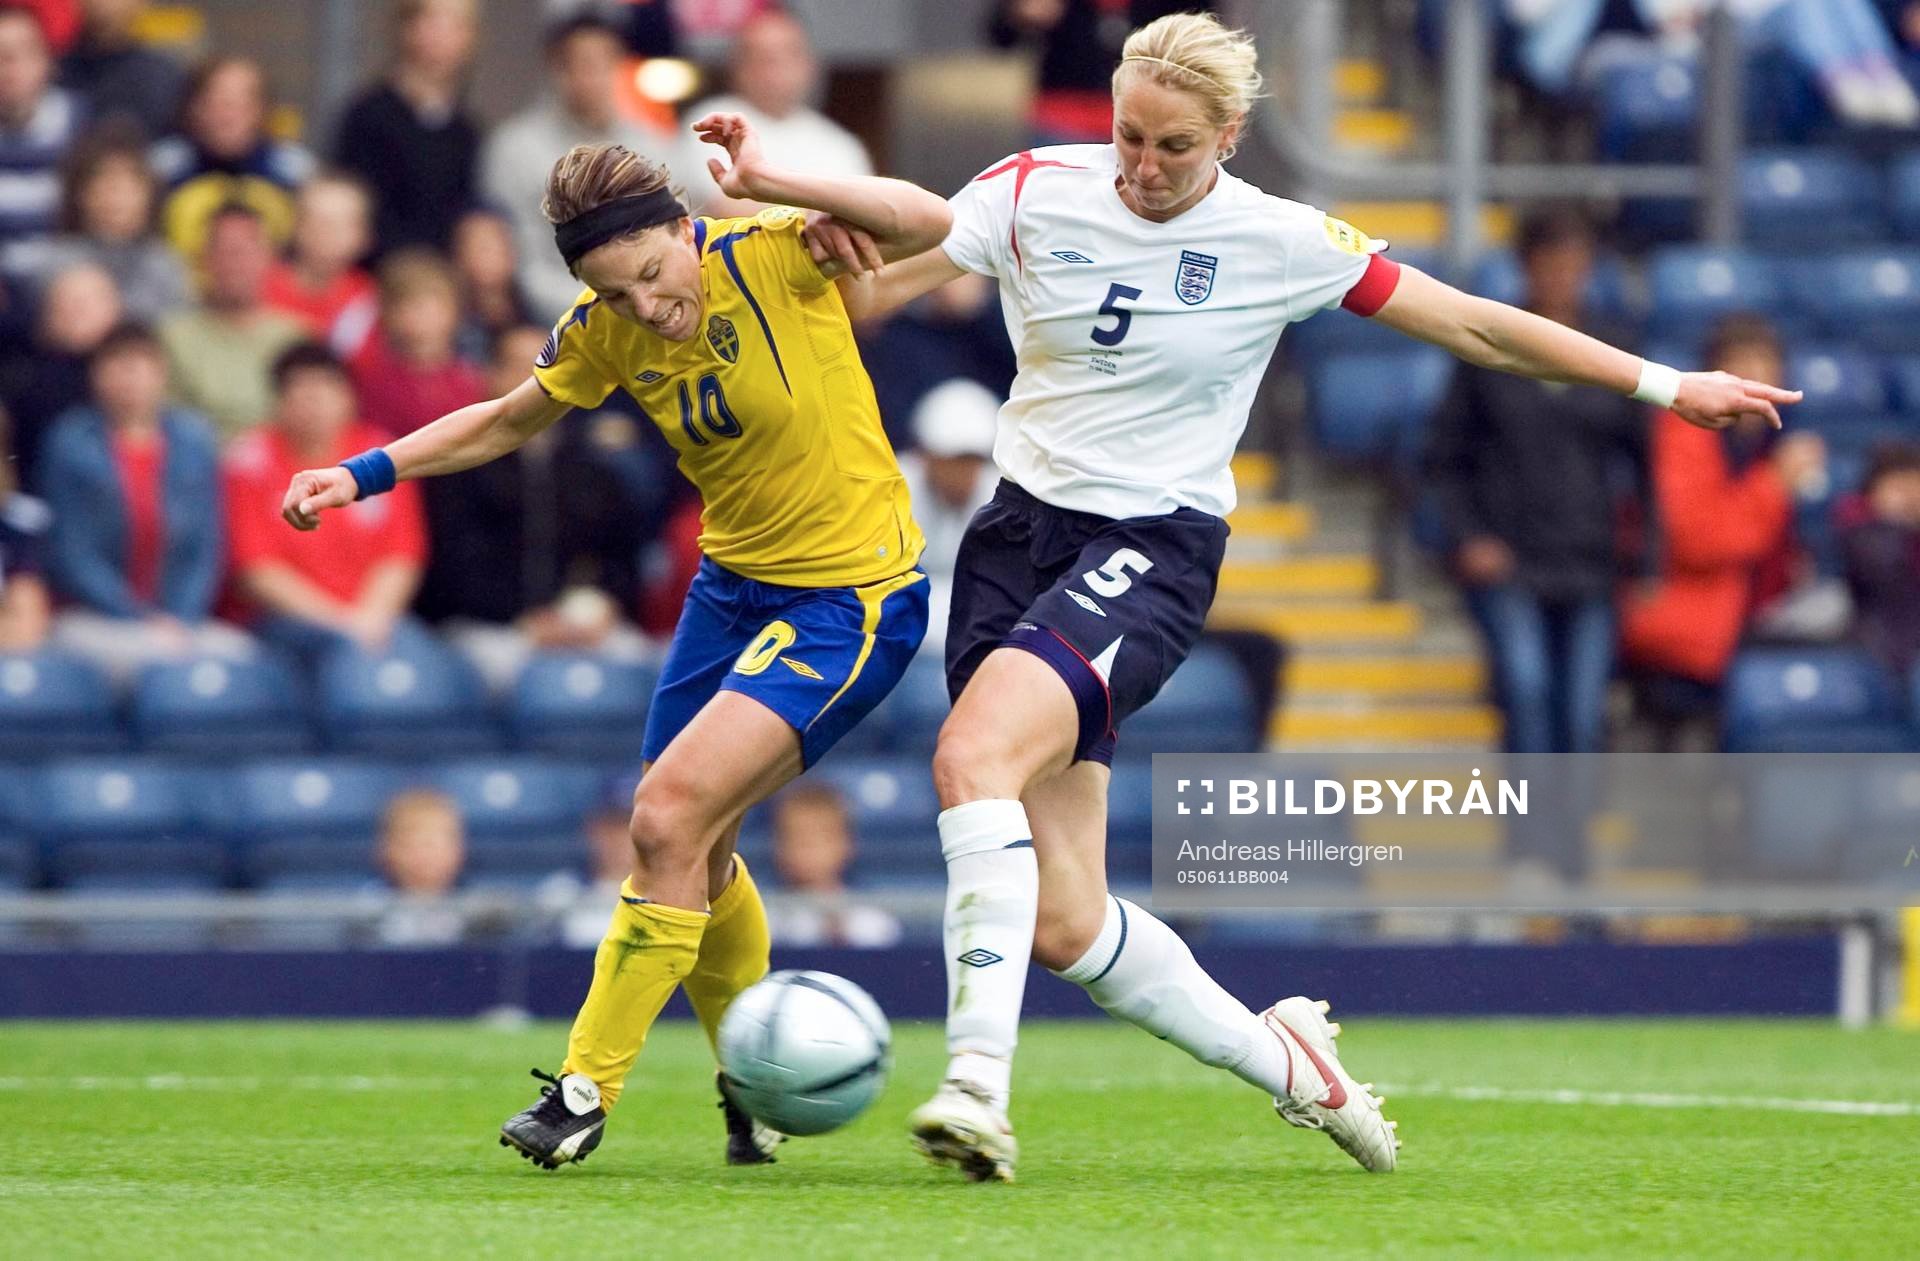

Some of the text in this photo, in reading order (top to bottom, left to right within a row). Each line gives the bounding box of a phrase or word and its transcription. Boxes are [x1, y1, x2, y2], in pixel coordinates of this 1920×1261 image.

[1183, 251, 1216, 265] ENGLAND
[1090, 283, 1142, 346] 5
[677, 372, 742, 446] 10
[1083, 547, 1154, 598] 5
